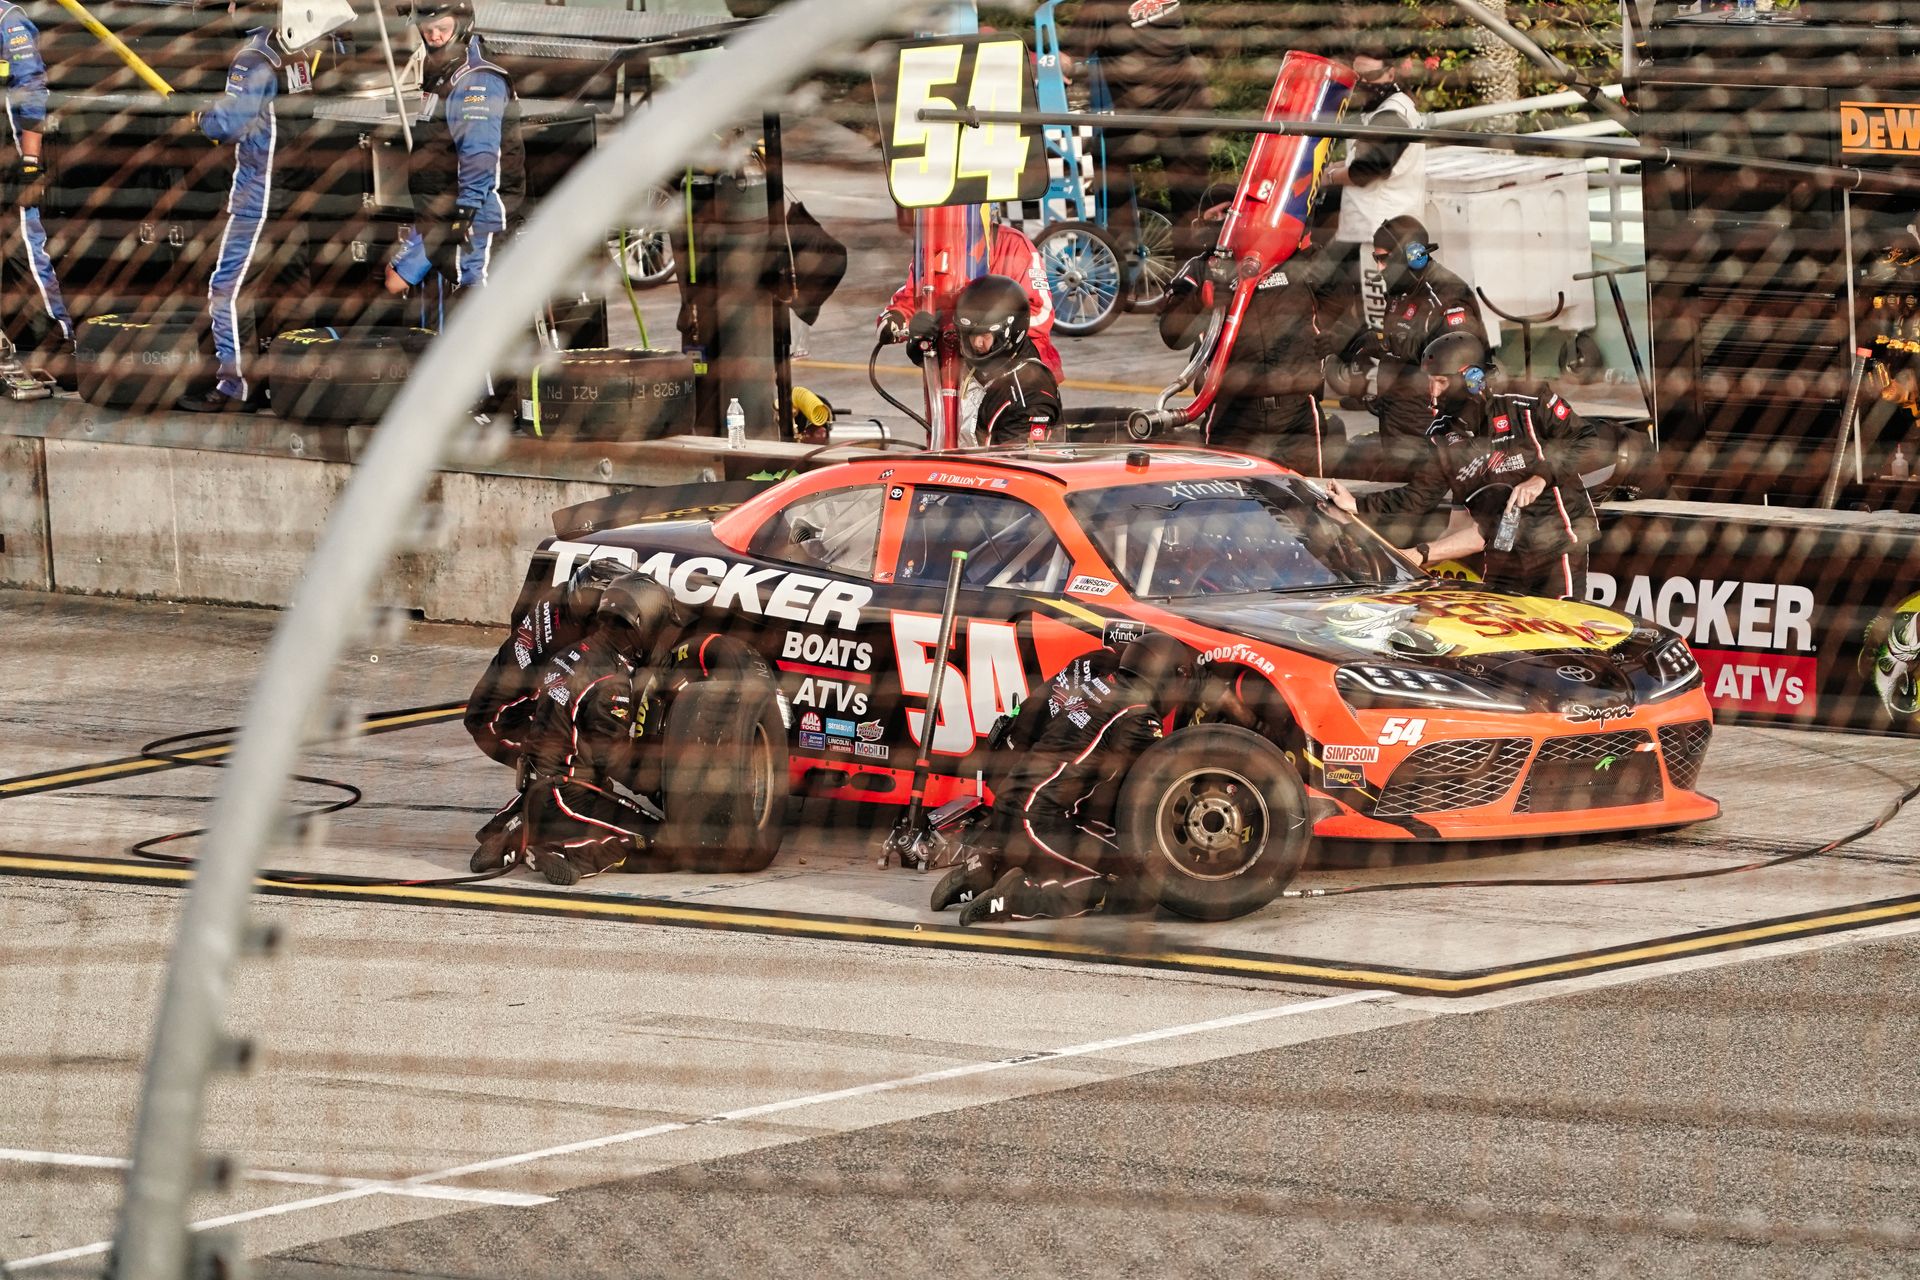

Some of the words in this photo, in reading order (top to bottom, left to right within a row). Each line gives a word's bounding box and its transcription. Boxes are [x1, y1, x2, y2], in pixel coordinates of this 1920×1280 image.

[1038, 54, 1056, 68] 43
[891, 40, 1030, 207] 54
[782, 630, 873, 672] BOATS
[1197, 644, 1275, 675] GOODYEAR
[792, 677, 868, 716] ATVs
[890, 609, 1031, 757] 54
[1713, 663, 1804, 705] ATVs
[1566, 704, 1637, 729] Supra
[1376, 718, 1428, 746] 54
[856, 742, 878, 755] Mobil
[1325, 746, 1376, 761] SIMPSON
[1328, 772, 1361, 780] SUNOCO
